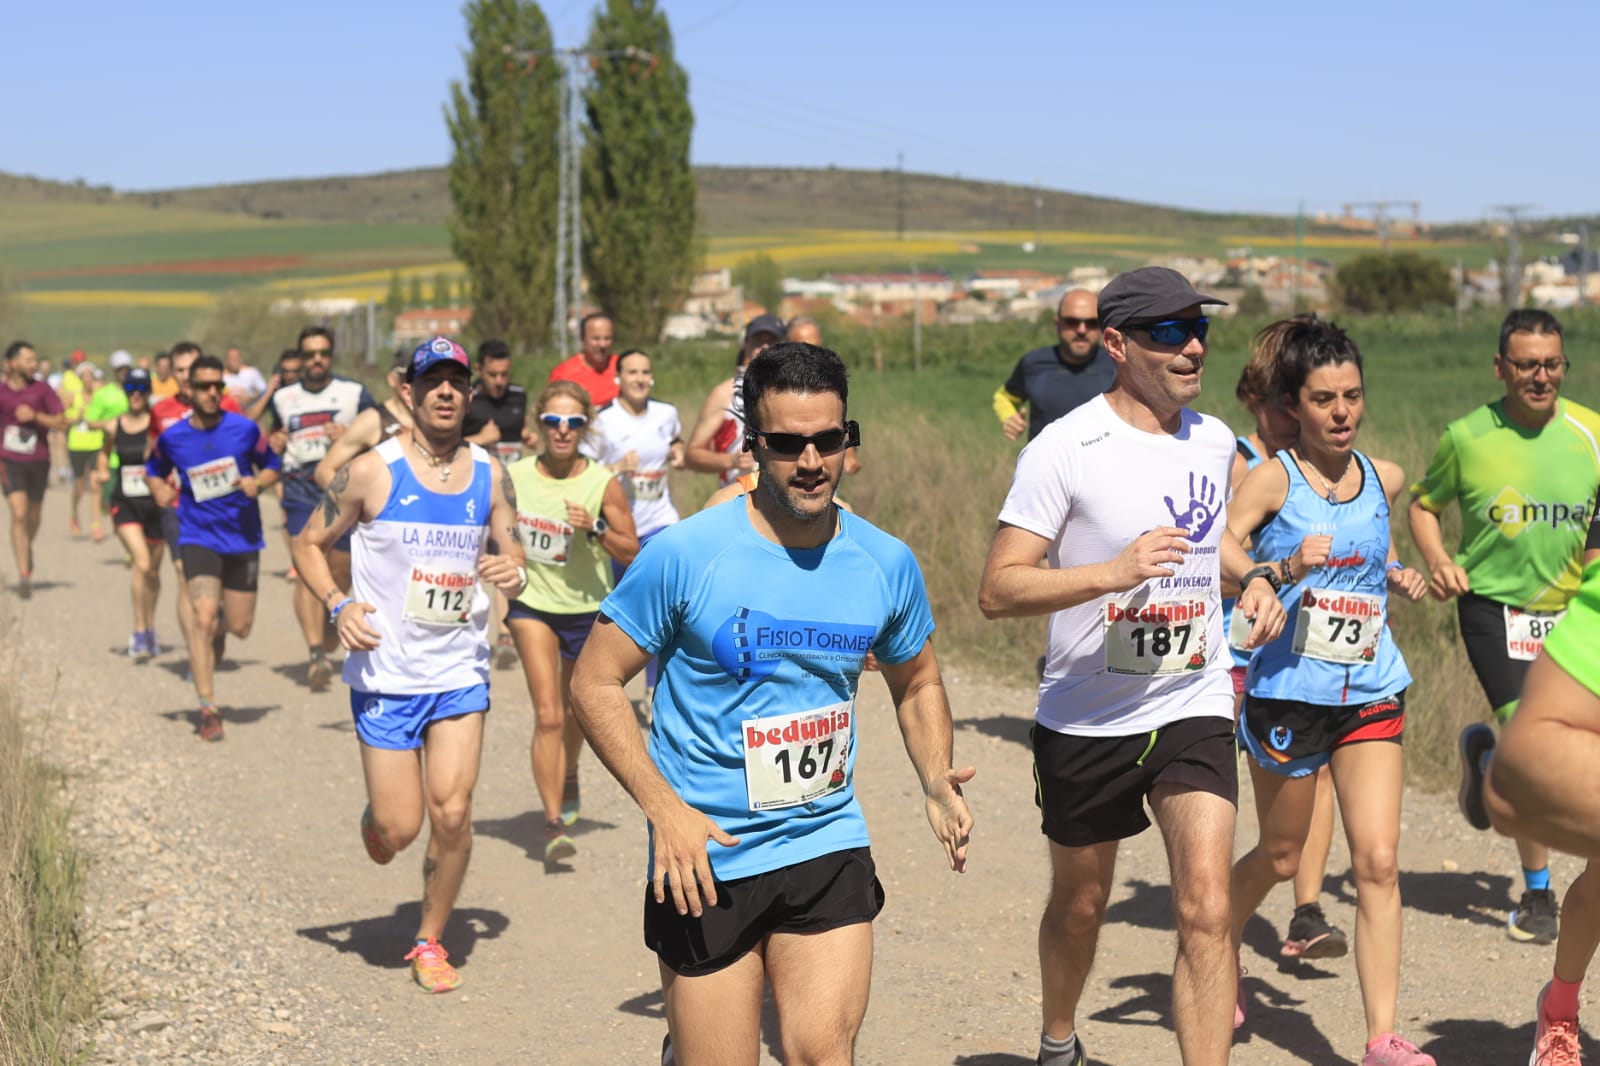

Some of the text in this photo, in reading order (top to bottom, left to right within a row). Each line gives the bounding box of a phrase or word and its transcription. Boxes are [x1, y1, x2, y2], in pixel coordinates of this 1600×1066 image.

[402, 527, 420, 546] LA
[529, 530, 551, 551] 10
[411, 567, 474, 588] bedunia
[1160, 577, 1171, 589] LA
[425, 588, 465, 611] 112
[1302, 587, 1382, 617] bedunia
[1108, 600, 1205, 624] bedunia
[1130, 624, 1191, 658] 187
[1328, 616, 1362, 645] 73
[746, 711, 850, 749] bedunia
[774, 738, 834, 784] 167
